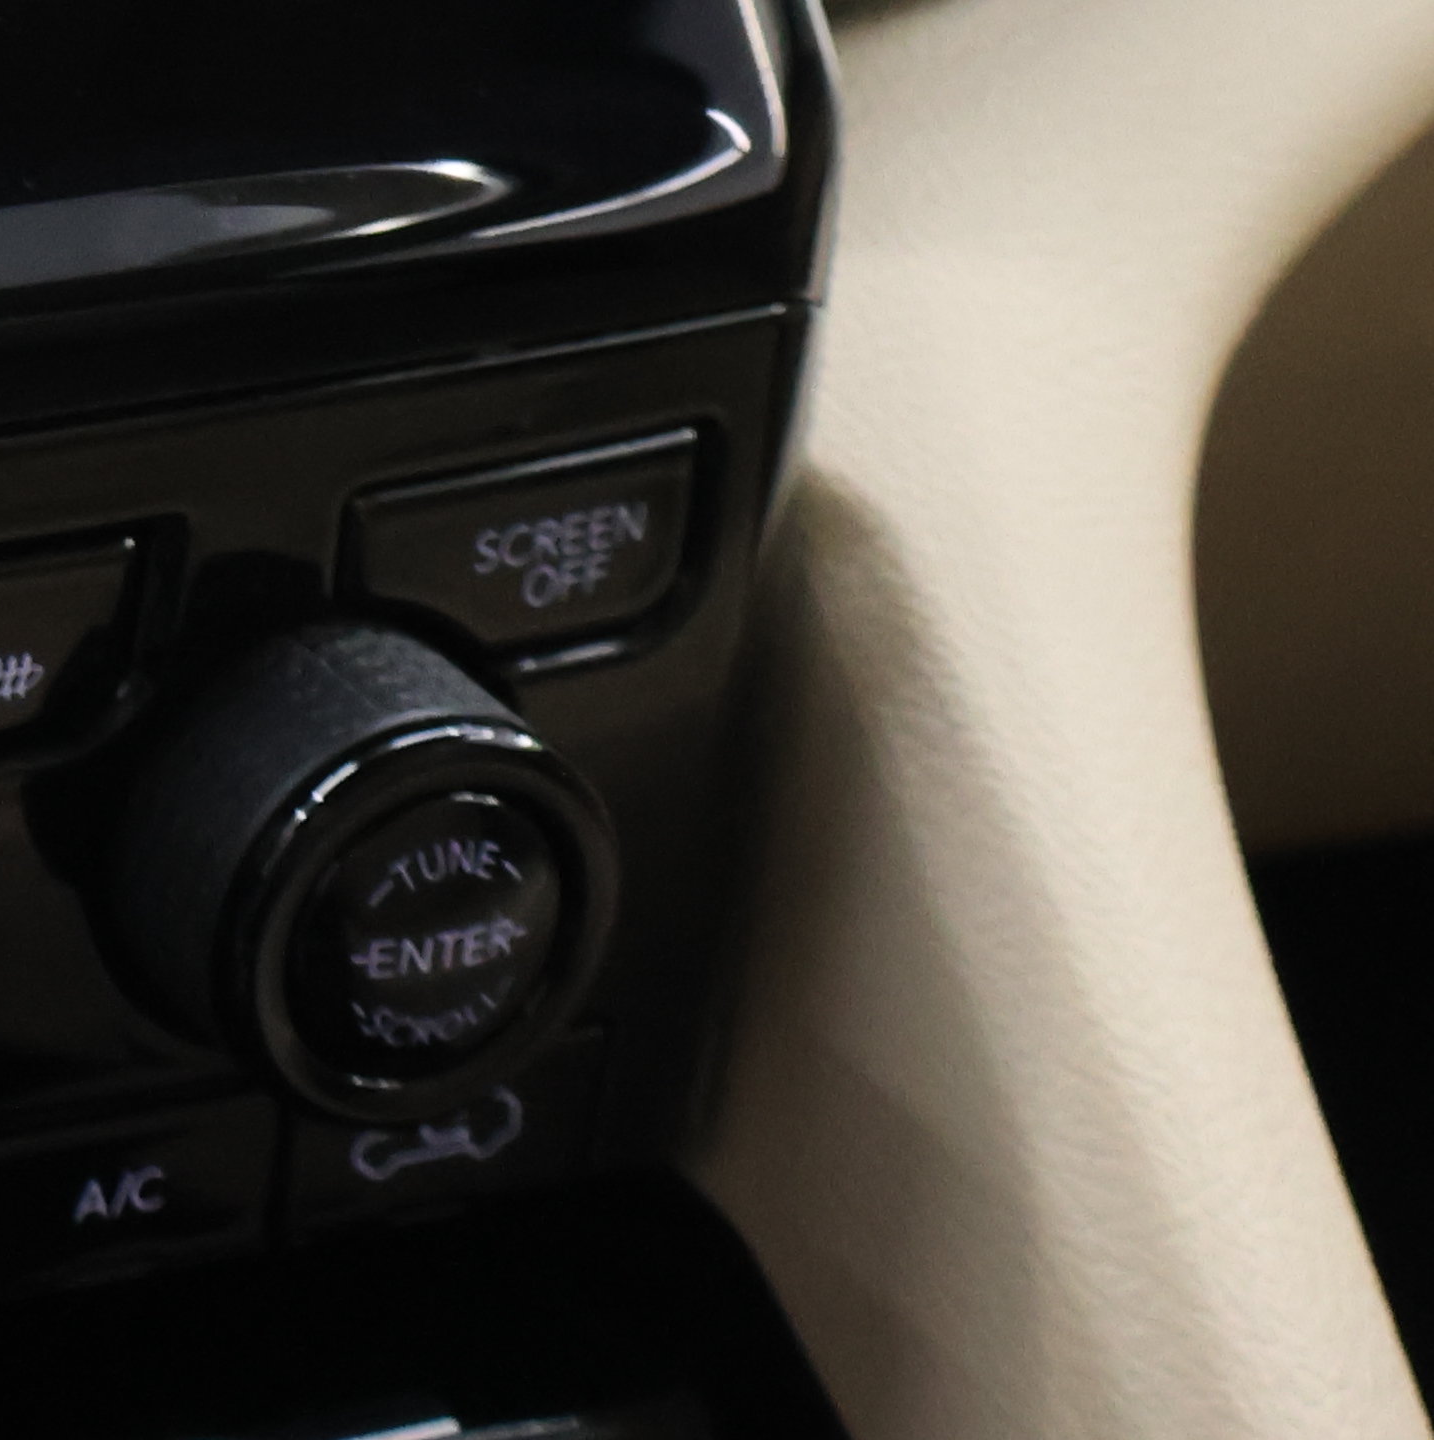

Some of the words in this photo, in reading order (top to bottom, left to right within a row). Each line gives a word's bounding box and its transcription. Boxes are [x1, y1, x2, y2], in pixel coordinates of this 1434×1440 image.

[473, 503, 648, 575] SCREEN
[522, 553, 610, 609] OFF
[74, 1164, 165, 1224] A/C
